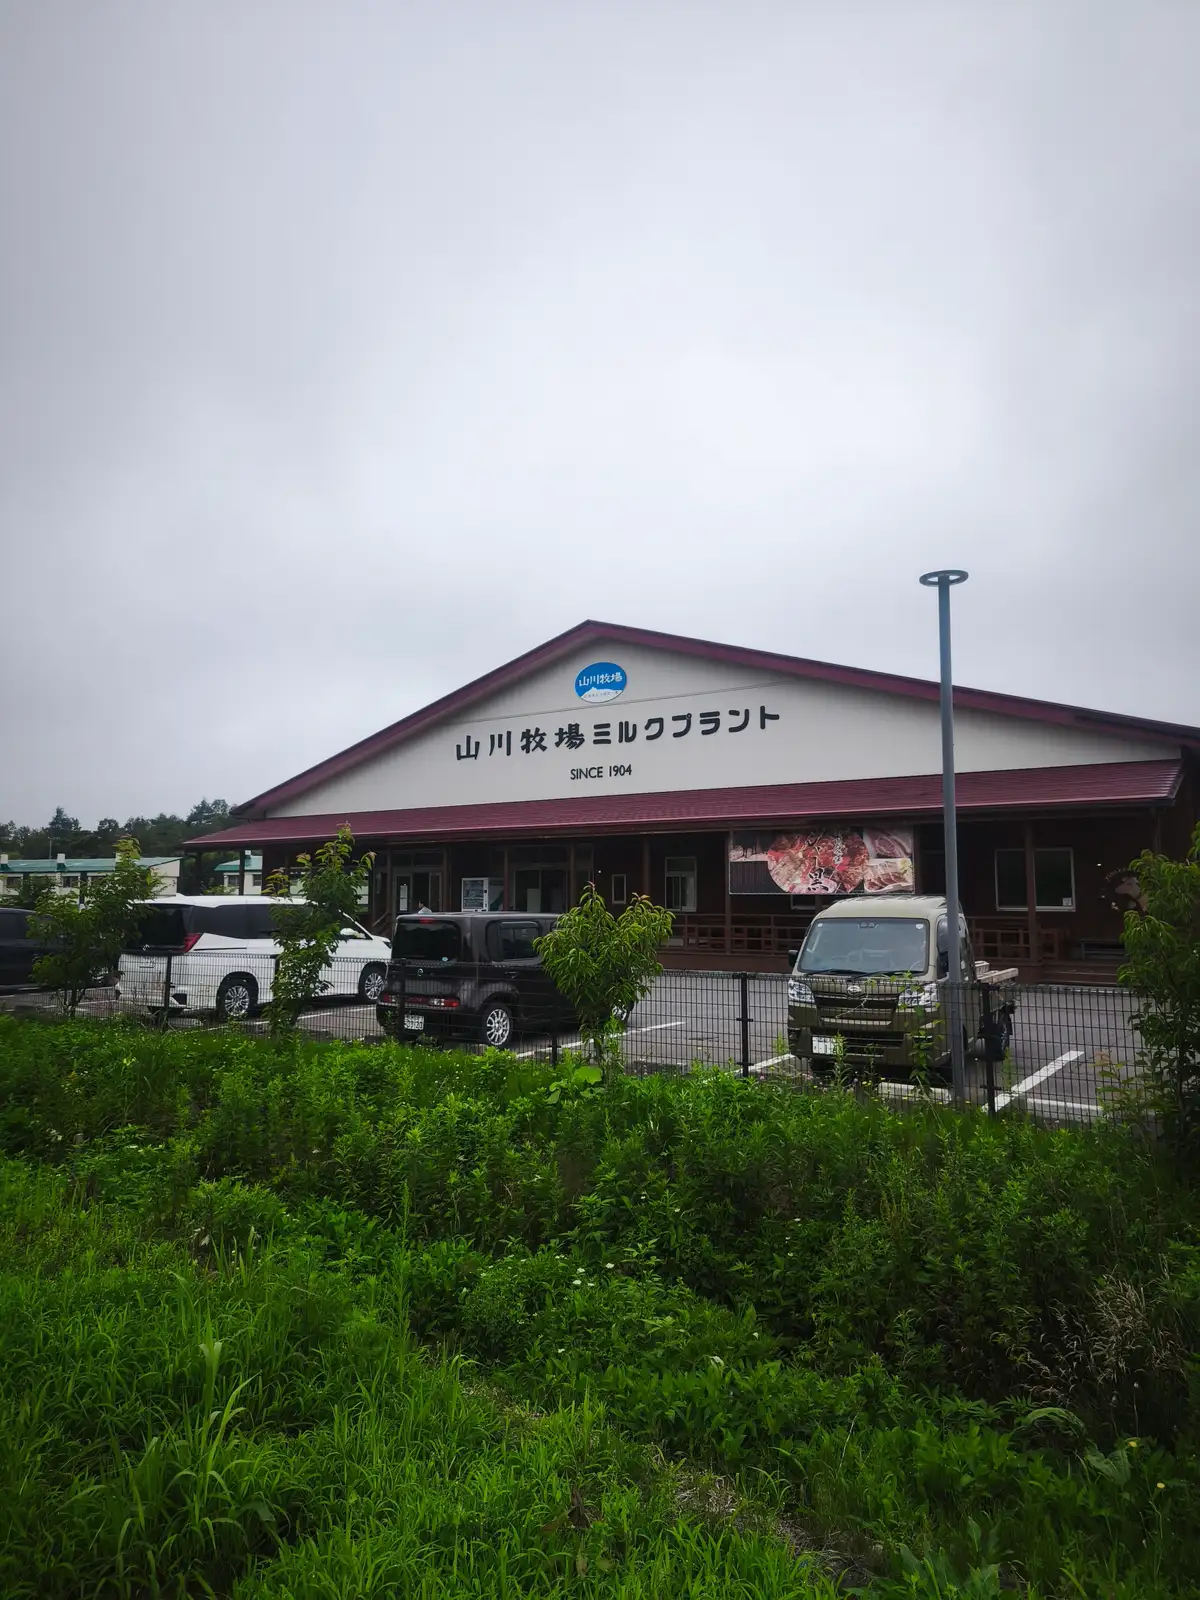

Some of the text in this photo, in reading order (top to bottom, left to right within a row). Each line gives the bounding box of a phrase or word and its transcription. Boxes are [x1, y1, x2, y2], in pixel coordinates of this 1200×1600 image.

[578, 671, 623, 687] 山川牧場
[455, 705, 780, 761] 山川牧場ミルクプラント
[570, 763, 633, 780] SINCE 1904
